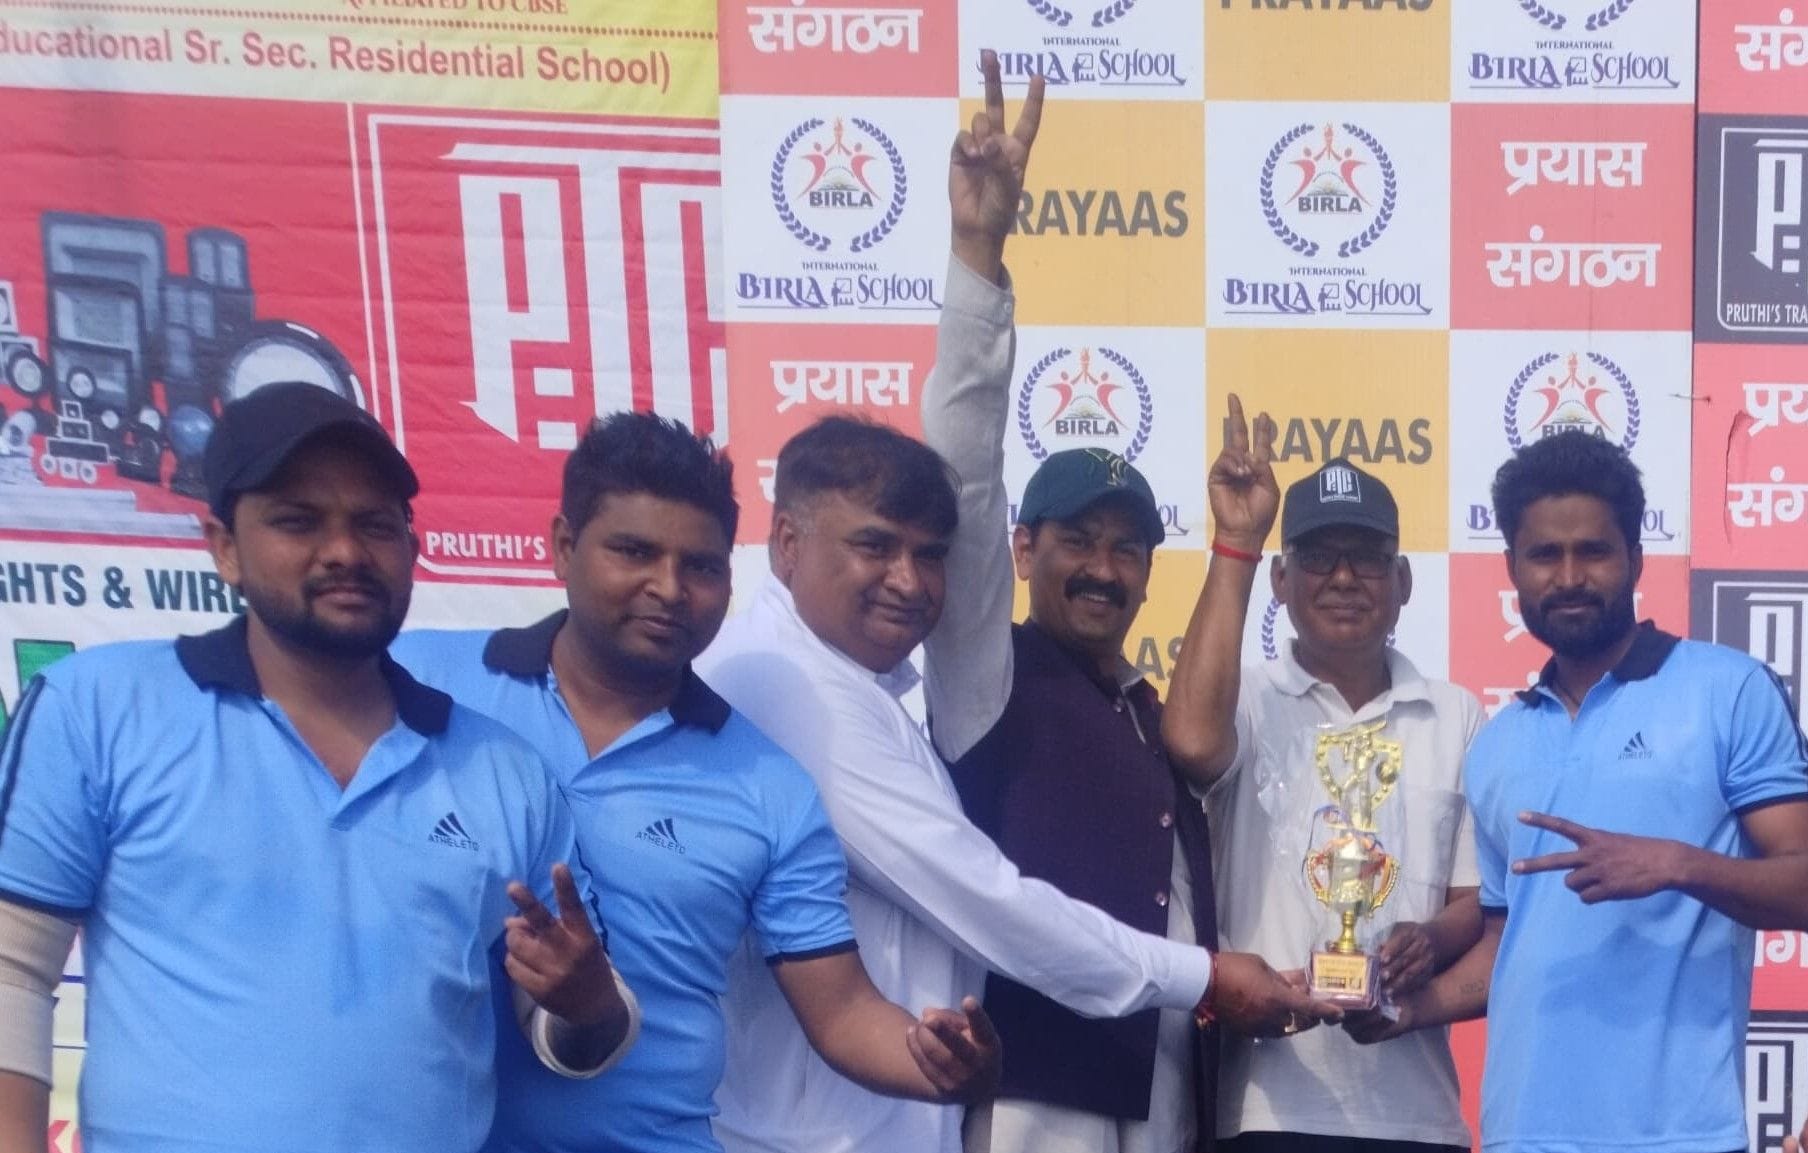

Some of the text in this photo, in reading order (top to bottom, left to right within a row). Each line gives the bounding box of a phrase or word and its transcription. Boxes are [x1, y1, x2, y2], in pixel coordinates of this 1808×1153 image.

[1042, 36, 1121, 47] INTERNATIONAL
[1535, 41, 1614, 50] INTERNATIONAL
[185, 31, 231, 66] Sr.
[243, 34, 317, 70] Sec.
[329, 36, 525, 80] Residential
[537, 43, 671, 93] School)
[977, 48, 1187, 86] IRLA SCHOOL
[1469, 52, 1680, 89] BIRLA SCHOOL
[1501, 141, 1647, 195] प्रयास
[809, 191, 874, 208] BIRLA
[1013, 190, 1189, 237] RAYAAS
[1297, 196, 1362, 213] BIRLA
[802, 261, 879, 272] INTERNATIONAL
[1289, 267, 1367, 277] INTERNATIONAL
[1485, 225, 1661, 288] संगठन
[736, 273, 943, 310] BIRLA SCHOOL
[1223, 278, 1433, 315] BIRLA SCHOOL
[1726, 303, 1782, 324] PRUTHI'S
[769, 361, 913, 413] प्रयास
[1054, 419, 1119, 436] BIRLA
[102, 566, 134, 609] &
